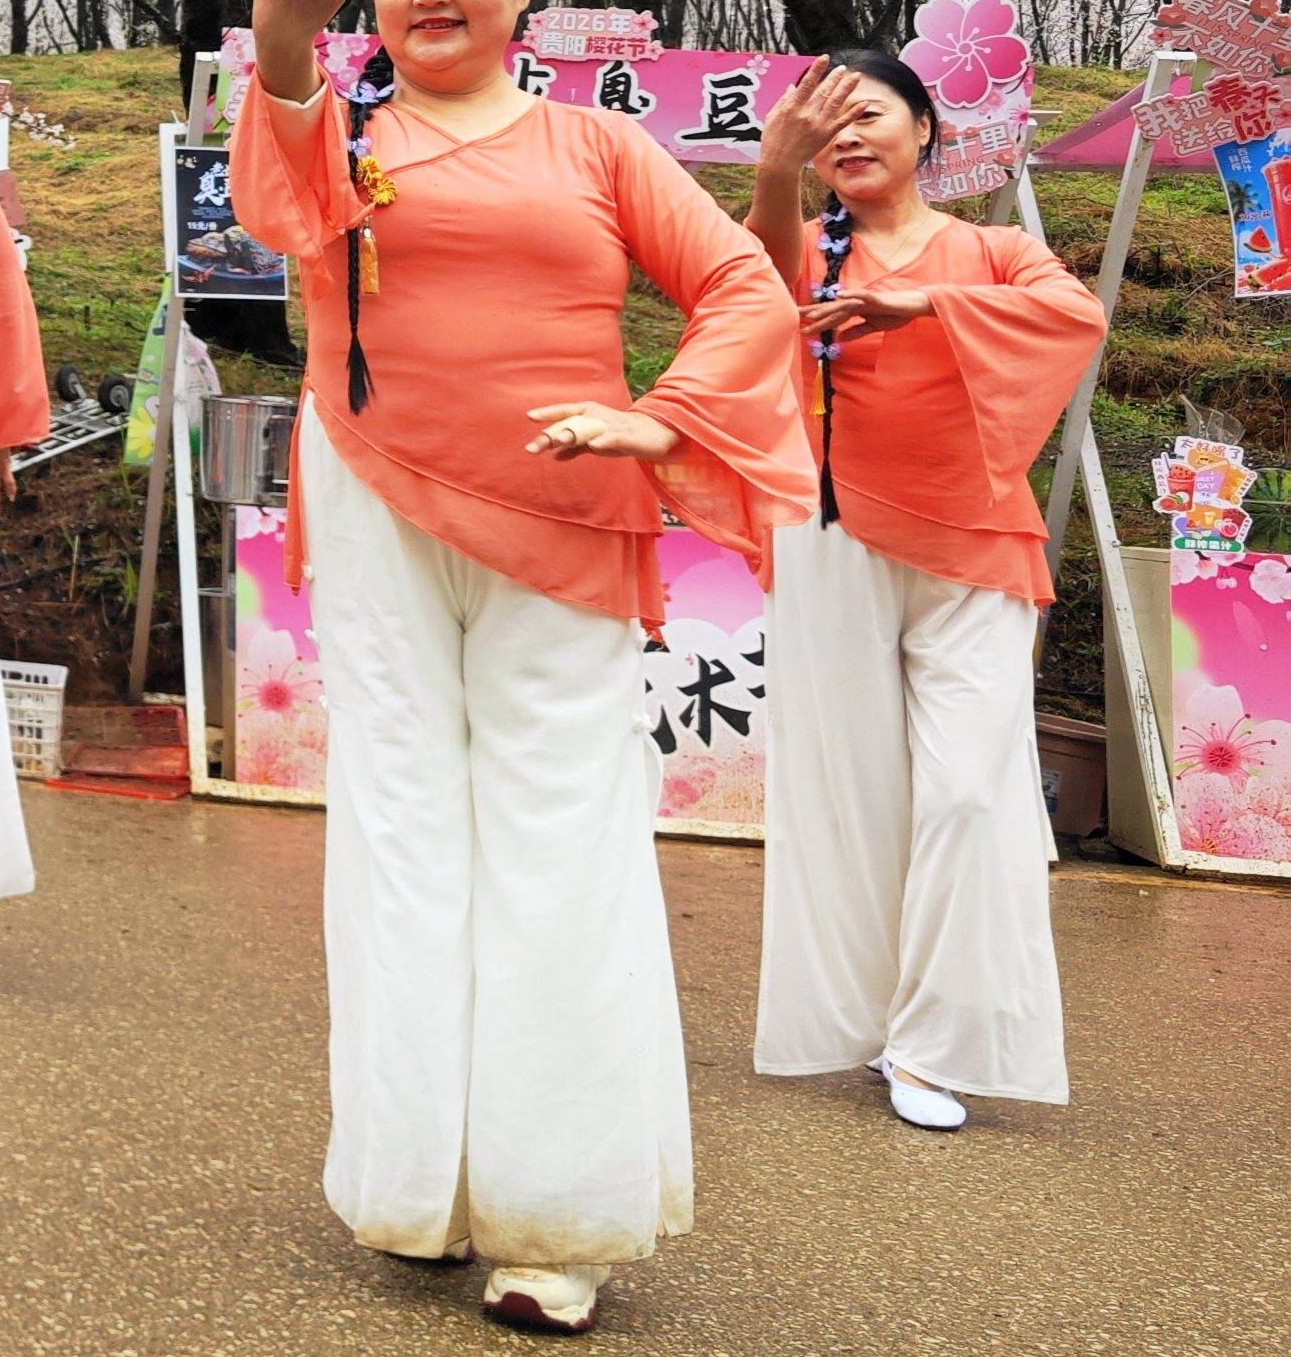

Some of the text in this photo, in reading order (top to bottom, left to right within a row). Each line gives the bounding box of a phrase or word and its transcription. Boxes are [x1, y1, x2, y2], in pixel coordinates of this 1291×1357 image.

[548, 13, 632, 34] 2026年
[541, 32, 648, 58] 贵阳樱花节
[1171, 21, 1270, 74] 不如你
